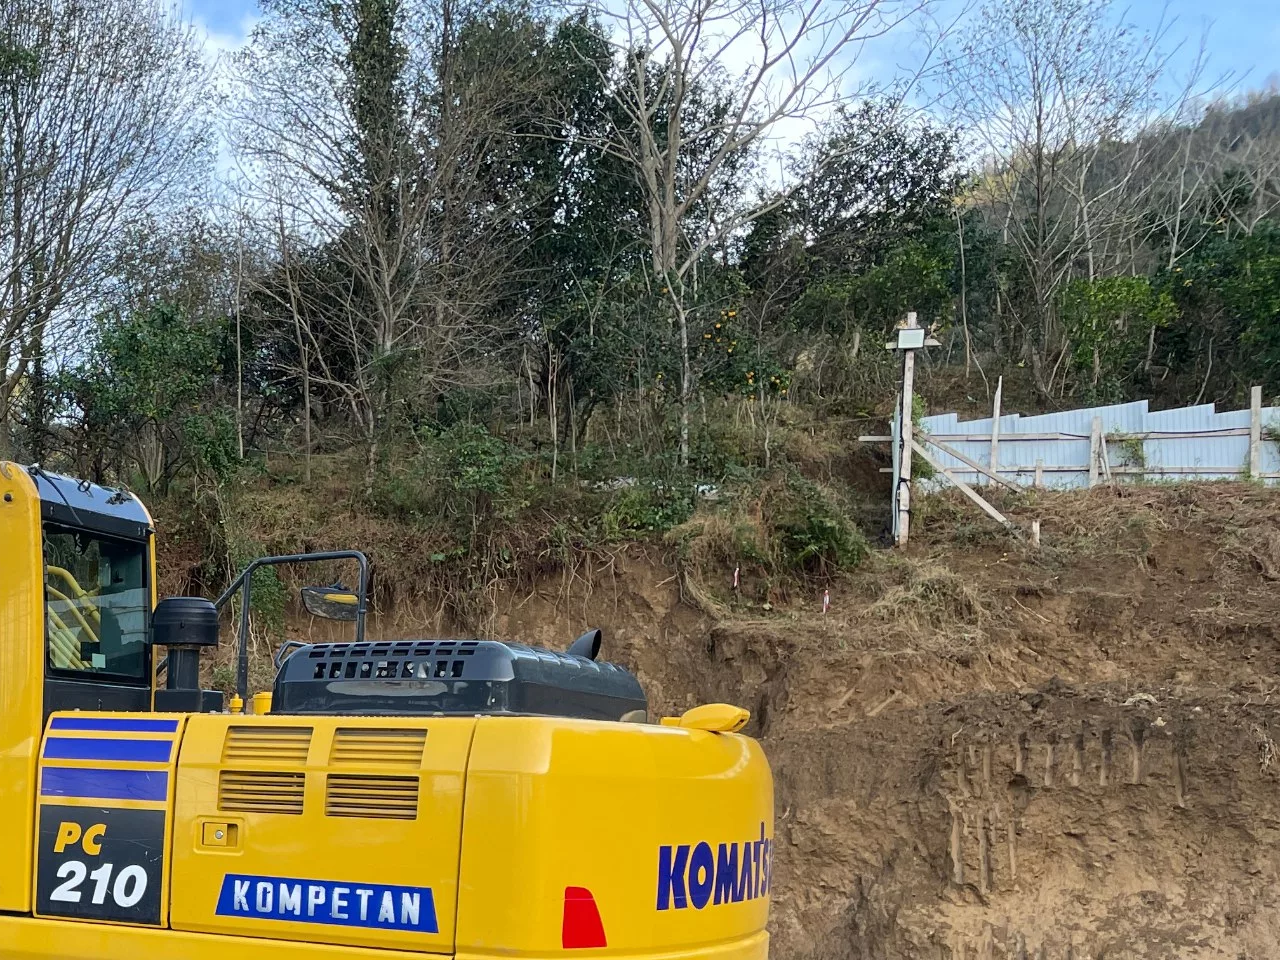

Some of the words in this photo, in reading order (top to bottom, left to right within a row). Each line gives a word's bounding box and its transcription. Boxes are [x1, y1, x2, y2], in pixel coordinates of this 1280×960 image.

[53, 821, 107, 856] PC
[49, 860, 148, 908] 210
[233, 879, 421, 925] KOMPETAN
